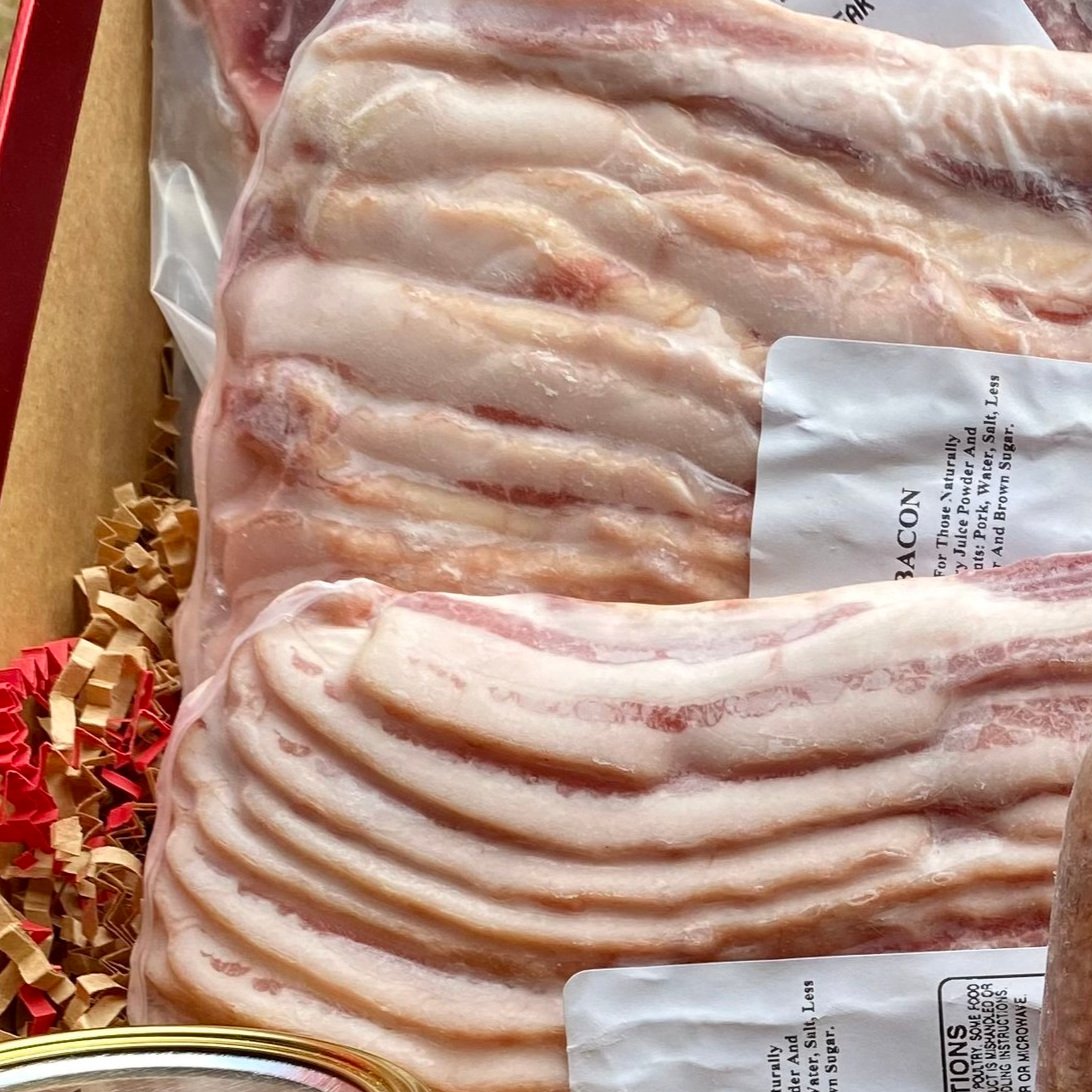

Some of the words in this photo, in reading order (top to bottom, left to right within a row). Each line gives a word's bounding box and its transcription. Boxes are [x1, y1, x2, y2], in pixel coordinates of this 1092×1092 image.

[985, 375, 1000, 406] Less
[964, 426, 977, 457] And
[982, 411, 999, 444] Salt,
[999, 423, 1016, 470] Sugar.
[940, 434, 961, 502] Naturally
[977, 448, 995, 496] Water,
[957, 461, 975, 515] Powder
[993, 475, 1010, 521] Brown
[936, 506, 951, 549] Those
[953, 519, 968, 557] Juice
[973, 500, 992, 541] Pork,
[991, 527, 1005, 557] And
[802, 980, 815, 1012] Less
[785, 1035, 800, 1065] And
[803, 1017, 819, 1048] Salt,
[825, 1026, 840, 1073] Sugar.
[1018, 1066, 1031, 1081] OR
